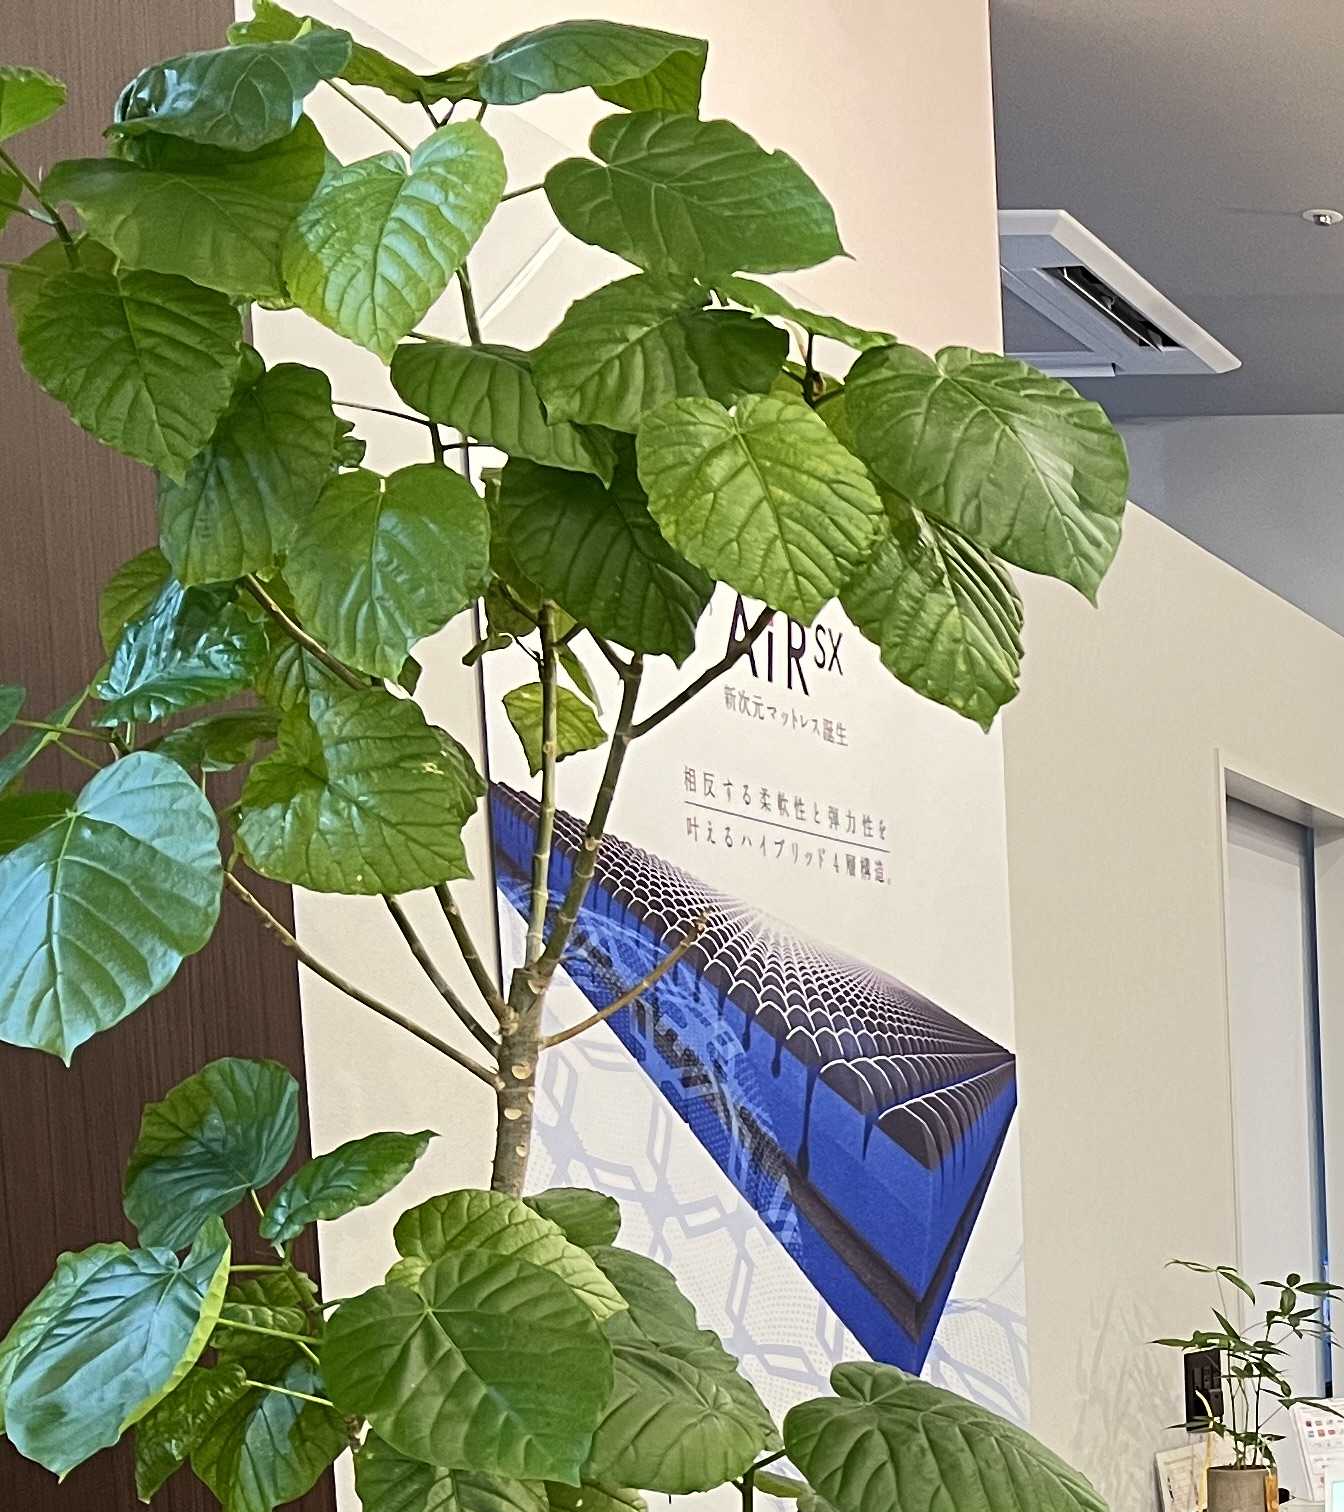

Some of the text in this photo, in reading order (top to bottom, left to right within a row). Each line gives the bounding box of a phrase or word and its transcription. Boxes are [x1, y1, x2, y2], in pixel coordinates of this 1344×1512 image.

[813, 623, 844, 677] SX
[723, 683, 849, 747] 新次元マットレス誕生
[683, 765, 888, 841] 相反する柔軟性と弾力性を
